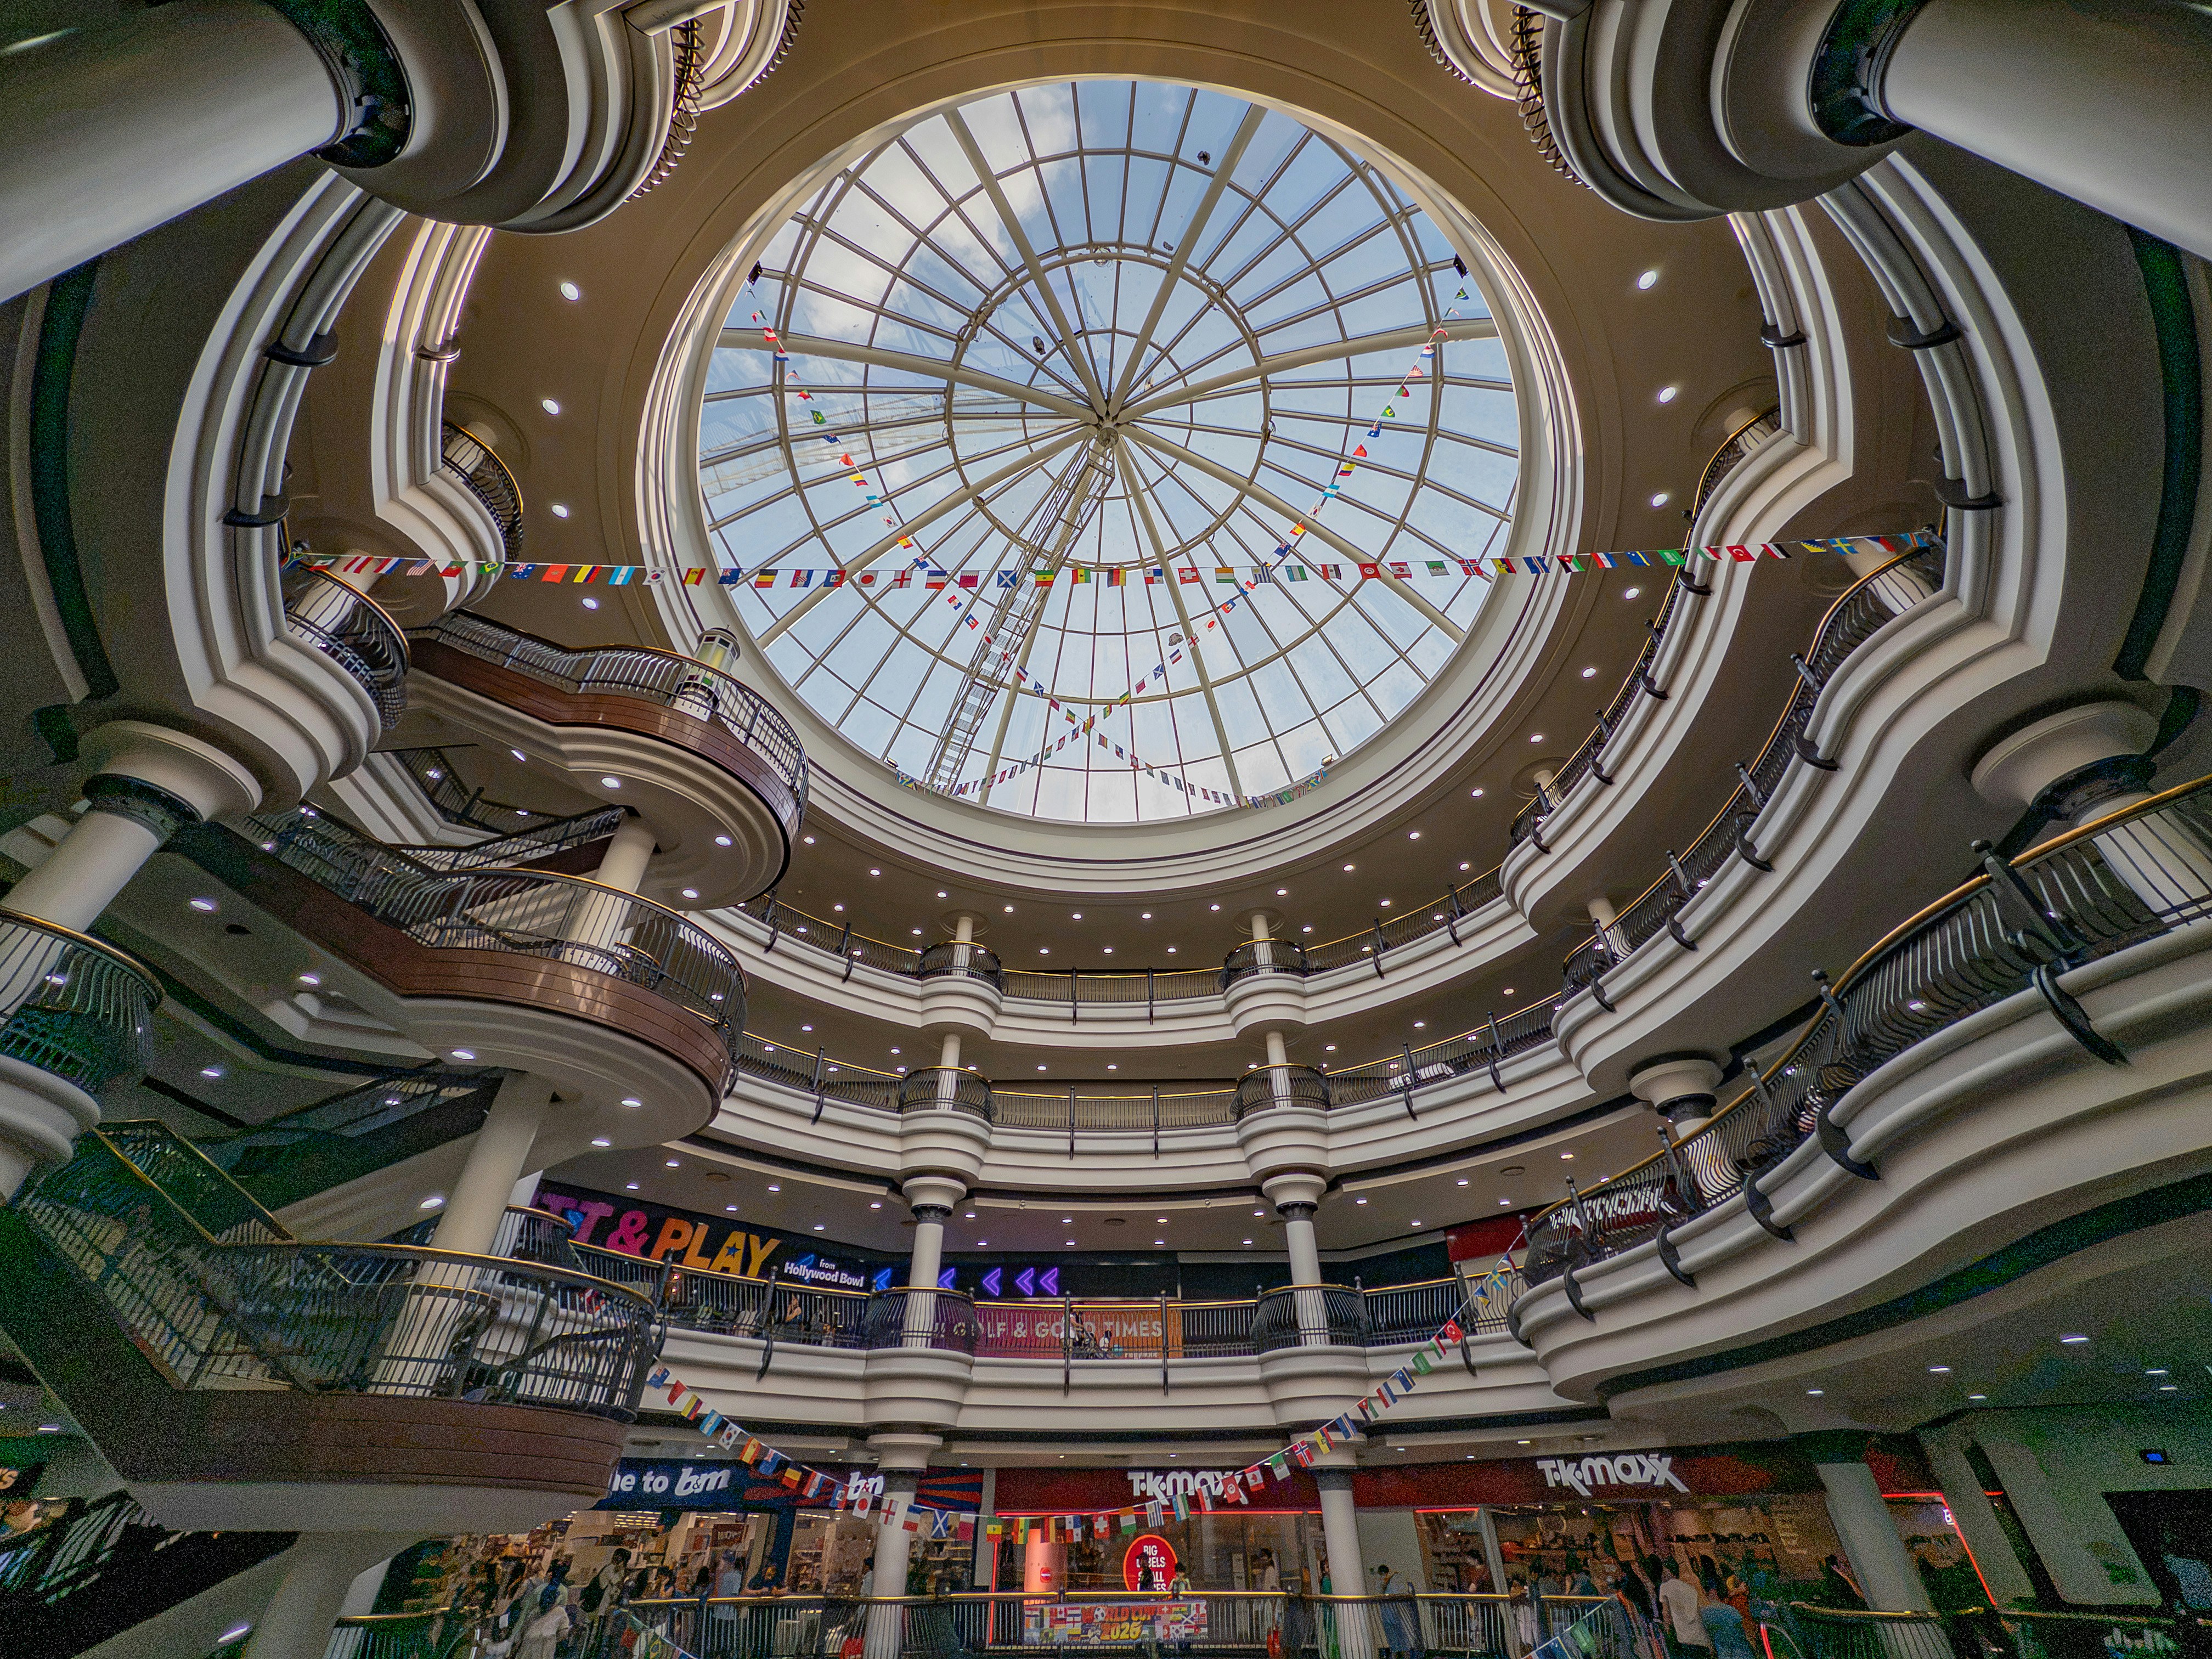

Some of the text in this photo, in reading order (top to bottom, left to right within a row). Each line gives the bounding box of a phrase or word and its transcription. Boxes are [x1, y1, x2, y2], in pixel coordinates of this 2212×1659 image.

[606, 1210, 650, 1257] &
[650, 1217, 782, 1277] PLAY
[820, 1259, 836, 1270] from
[784, 1262, 865, 1288] Hollywood Bowl
[1014, 1322, 1026, 1338] &
[1103, 1321, 1163, 1338] TIMES
[642, 1471, 669, 1493] to
[674, 1467, 731, 1497] b&m
[1143, 1545, 1158, 1556] BIG
[1100, 1621, 1143, 1641] 2026
